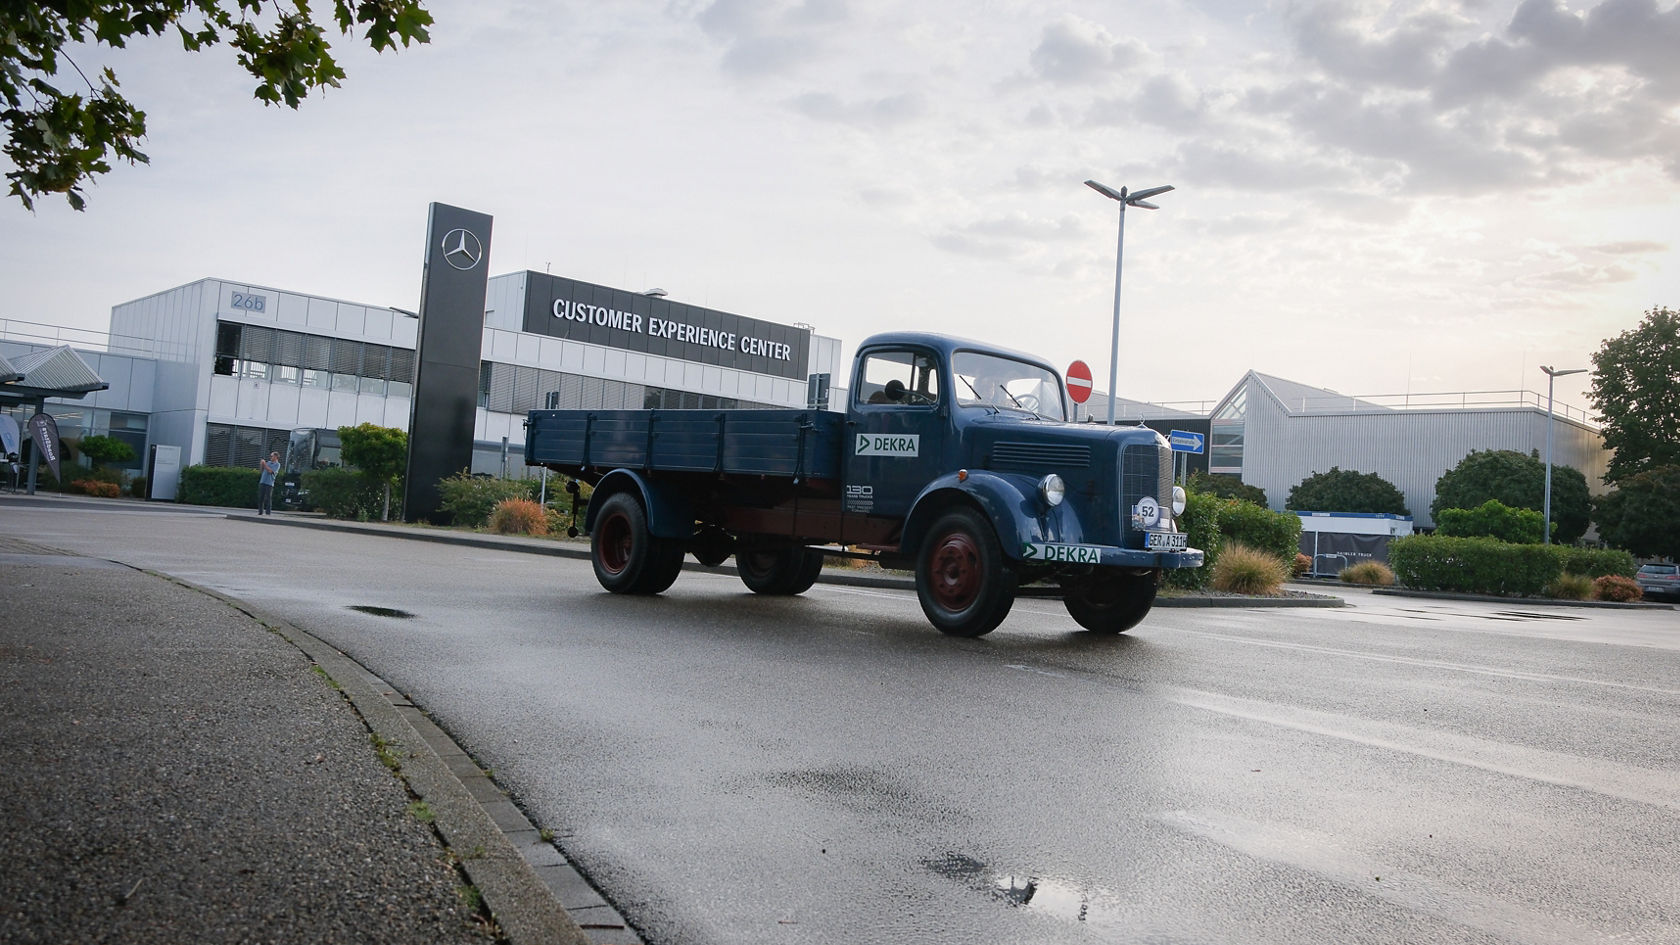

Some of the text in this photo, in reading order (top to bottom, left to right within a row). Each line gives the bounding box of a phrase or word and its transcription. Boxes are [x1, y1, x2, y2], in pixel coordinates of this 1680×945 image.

[234, 294, 264, 310] 26b
[553, 298, 791, 361] CUSTOMER EXPERIENCE CENTER
[874, 437, 916, 452] DEKRA
[846, 484, 873, 494] 130
[1142, 506, 1154, 518] 52
[1150, 534, 1162, 546] GER
[1172, 535, 1187, 548] 311H
[1044, 546, 1098, 562] DEKRA
